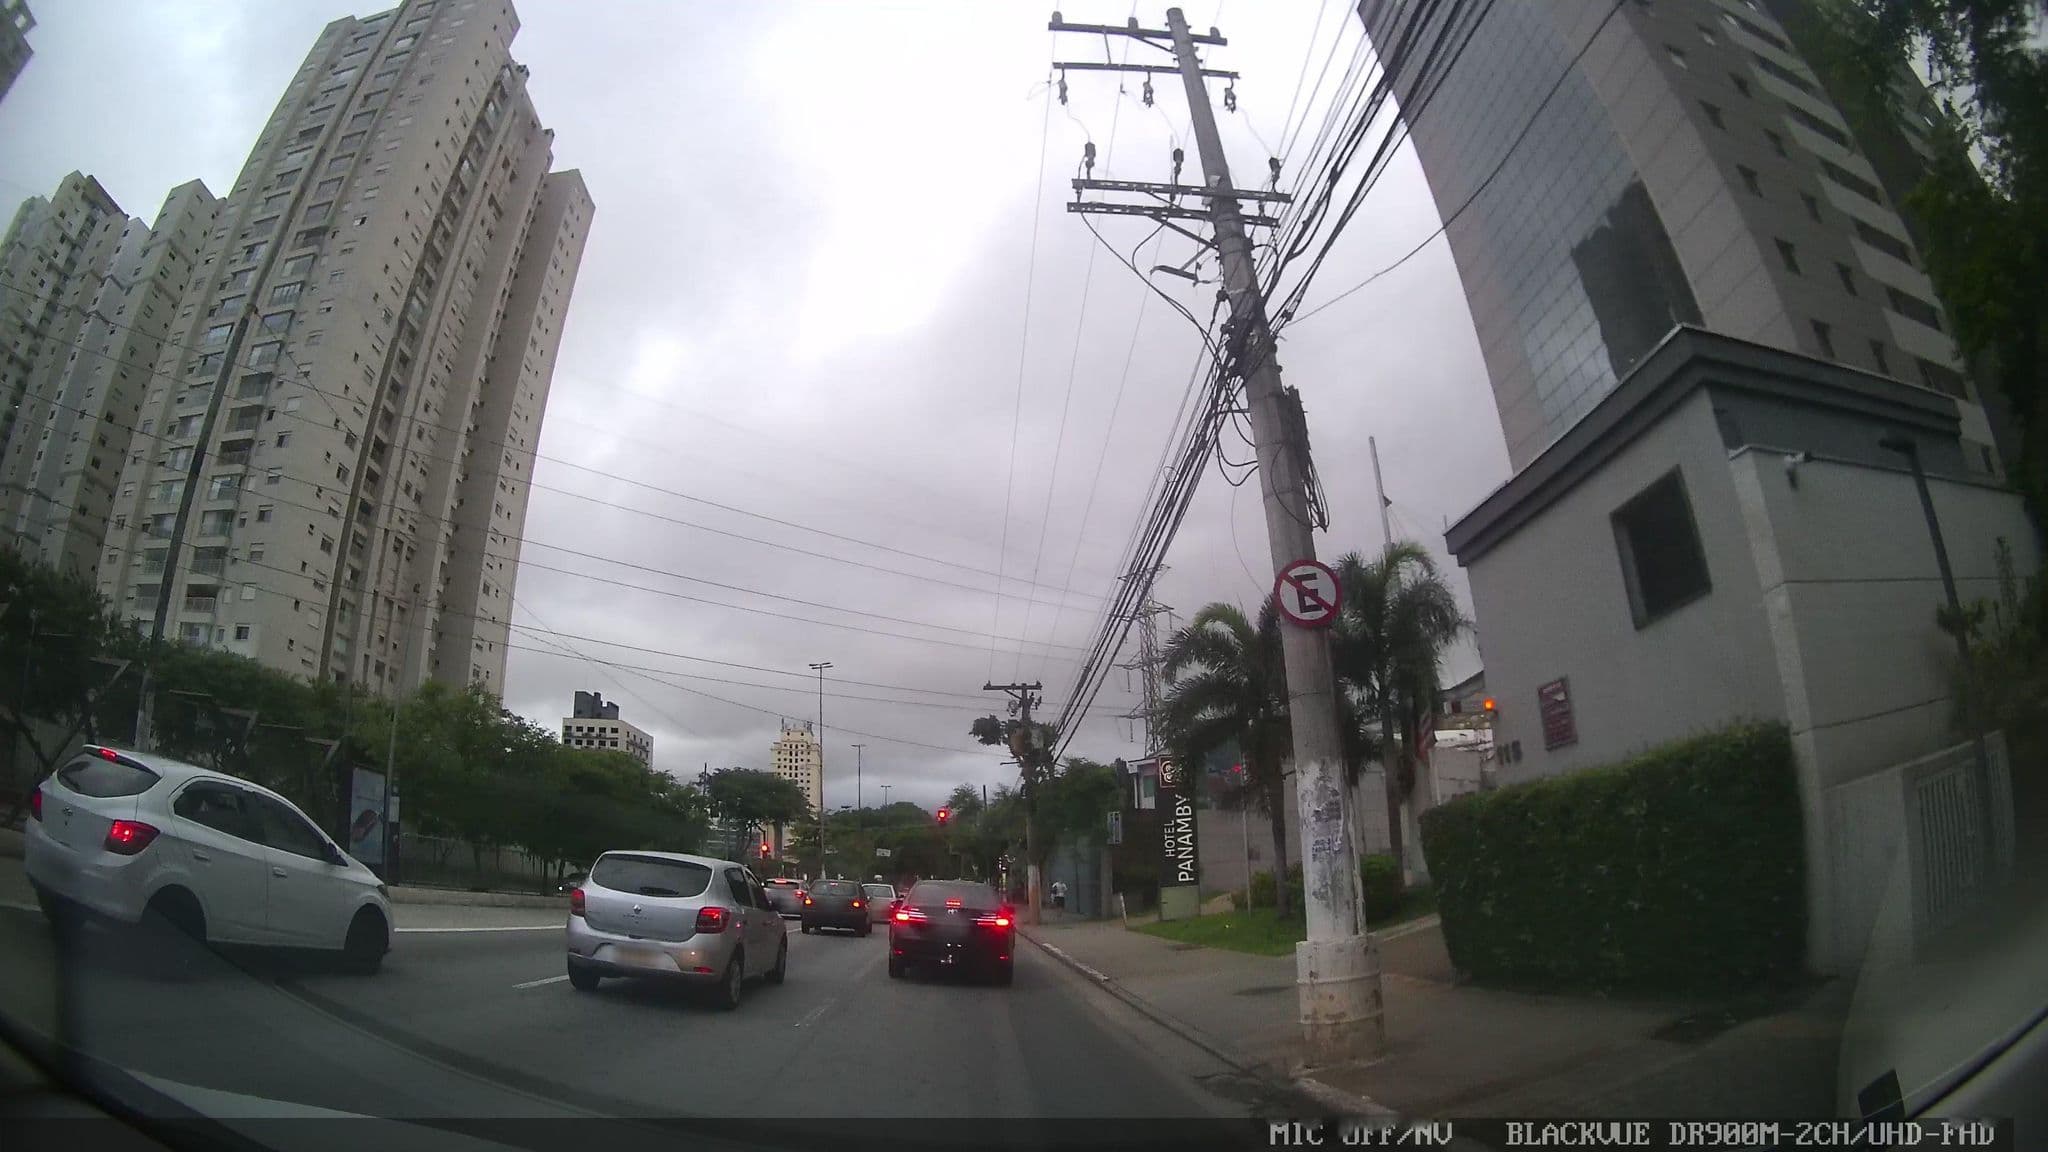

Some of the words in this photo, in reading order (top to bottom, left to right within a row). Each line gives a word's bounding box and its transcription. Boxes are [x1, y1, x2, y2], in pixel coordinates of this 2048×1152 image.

[1294, 572, 1323, 614] E
[1164, 820, 1176, 857] HOTEL
[1175, 793, 1194, 882] PANAMBY
